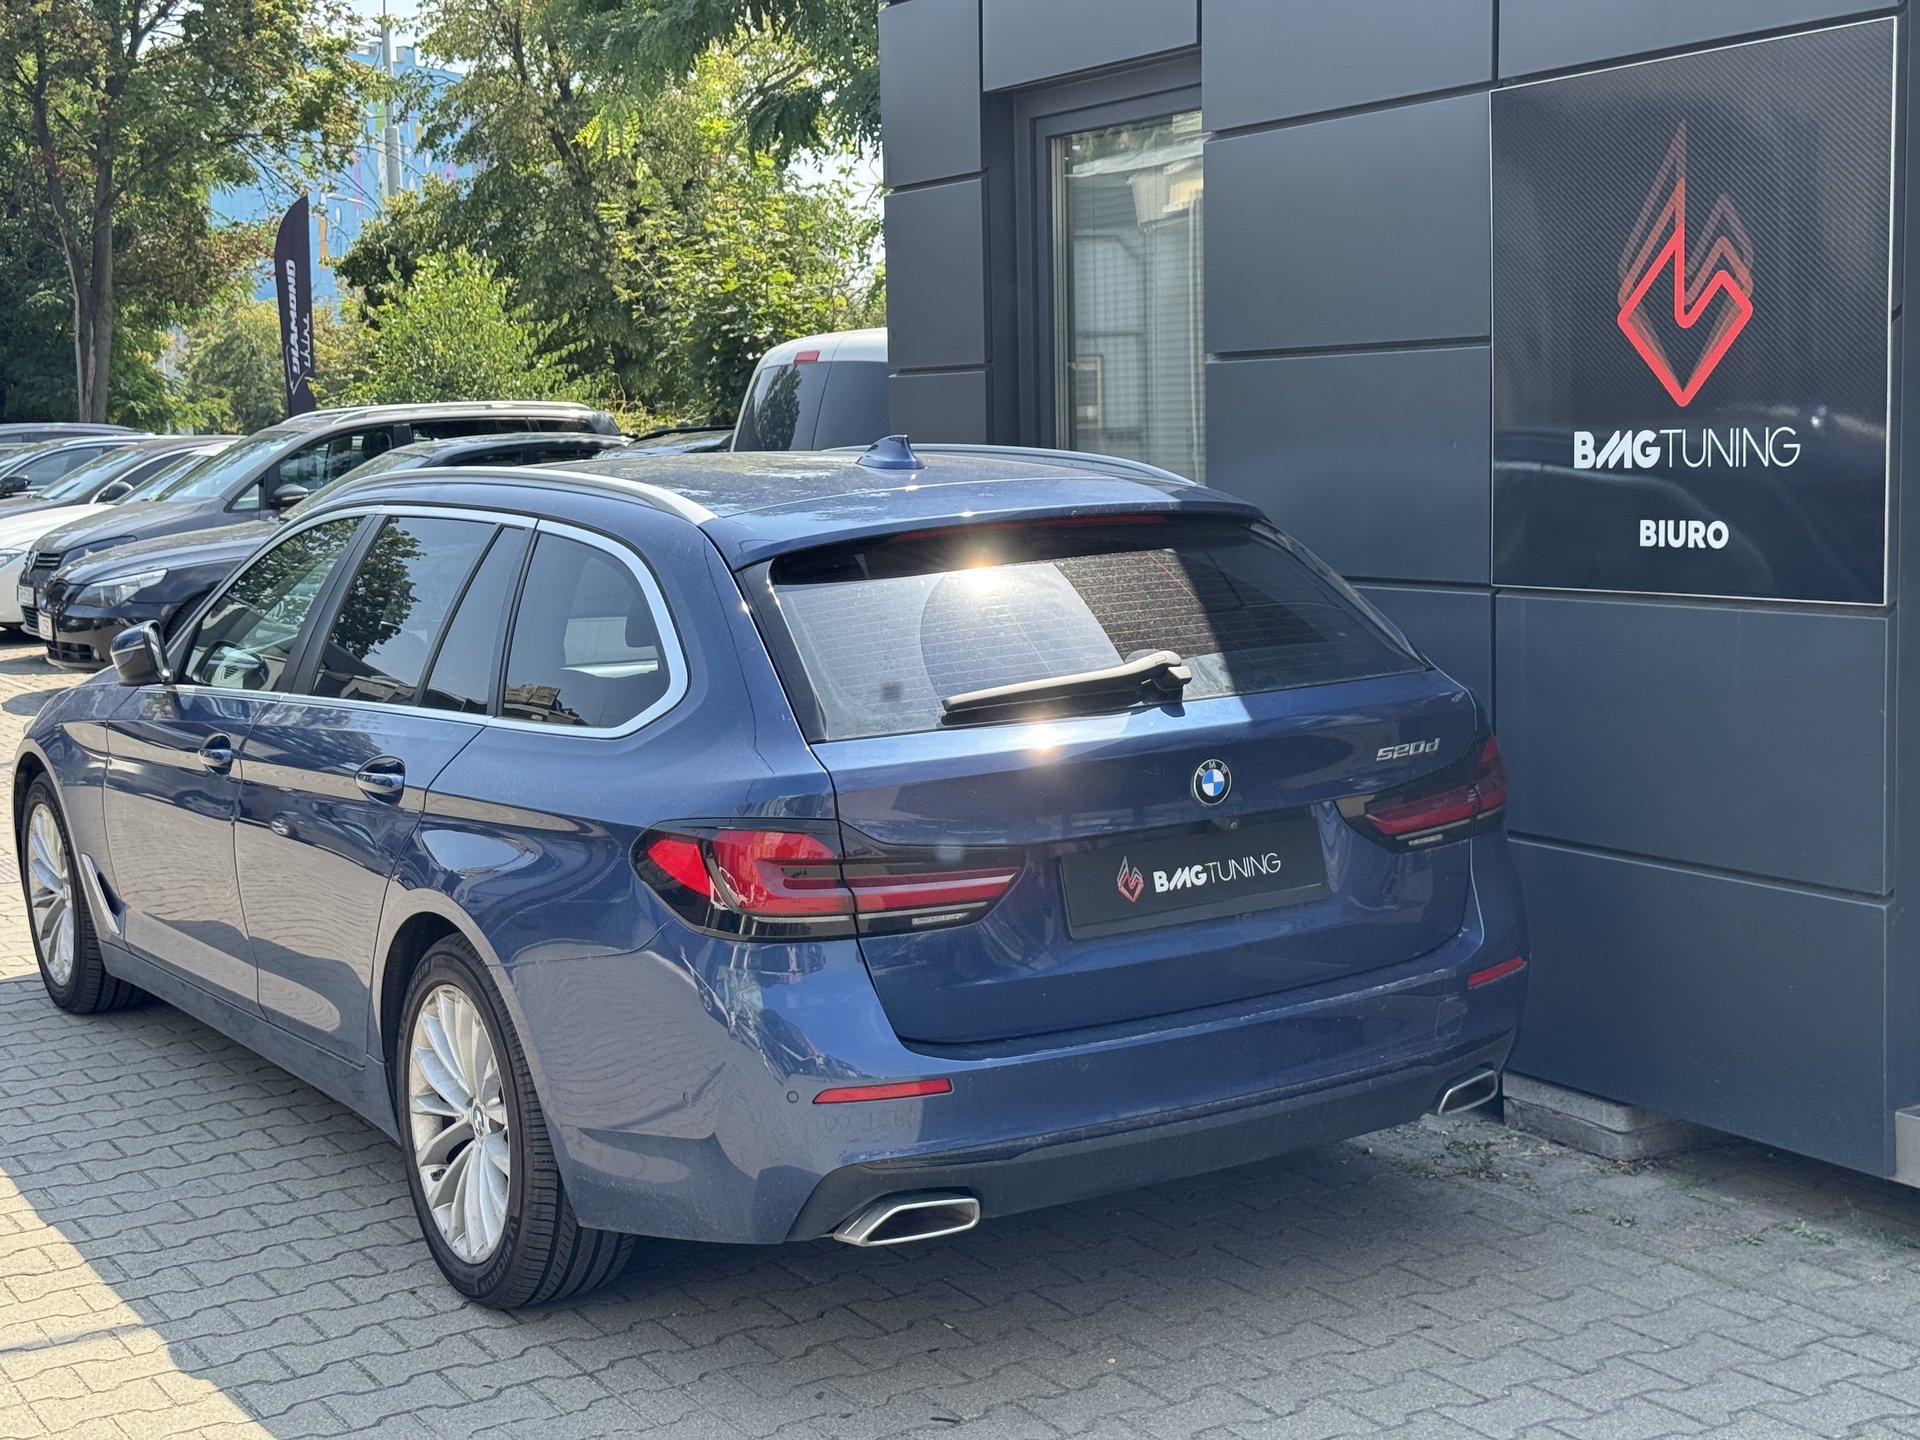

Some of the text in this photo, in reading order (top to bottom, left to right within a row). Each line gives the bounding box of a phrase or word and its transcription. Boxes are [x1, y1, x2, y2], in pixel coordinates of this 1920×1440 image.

[285, 259, 300, 374] DIAMOND
[1639, 519, 1729, 549] BIURO
[1376, 737, 1440, 761] 520d
